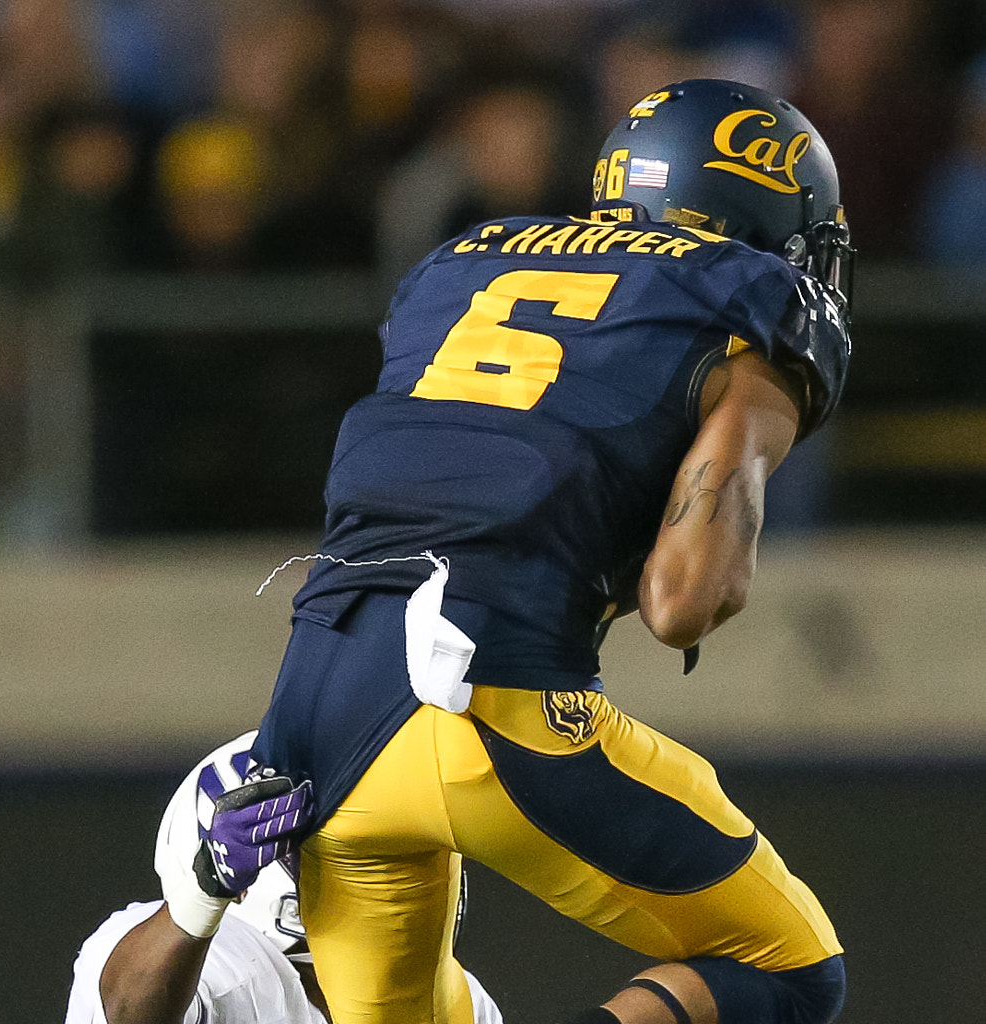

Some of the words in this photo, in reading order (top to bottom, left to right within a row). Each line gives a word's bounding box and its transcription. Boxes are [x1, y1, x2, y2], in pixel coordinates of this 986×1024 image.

[606, 149, 629, 200] 6
[703, 109, 811, 194] Cal
[501, 224, 701, 258] HARPER
[409, 270, 620, 410] 6
